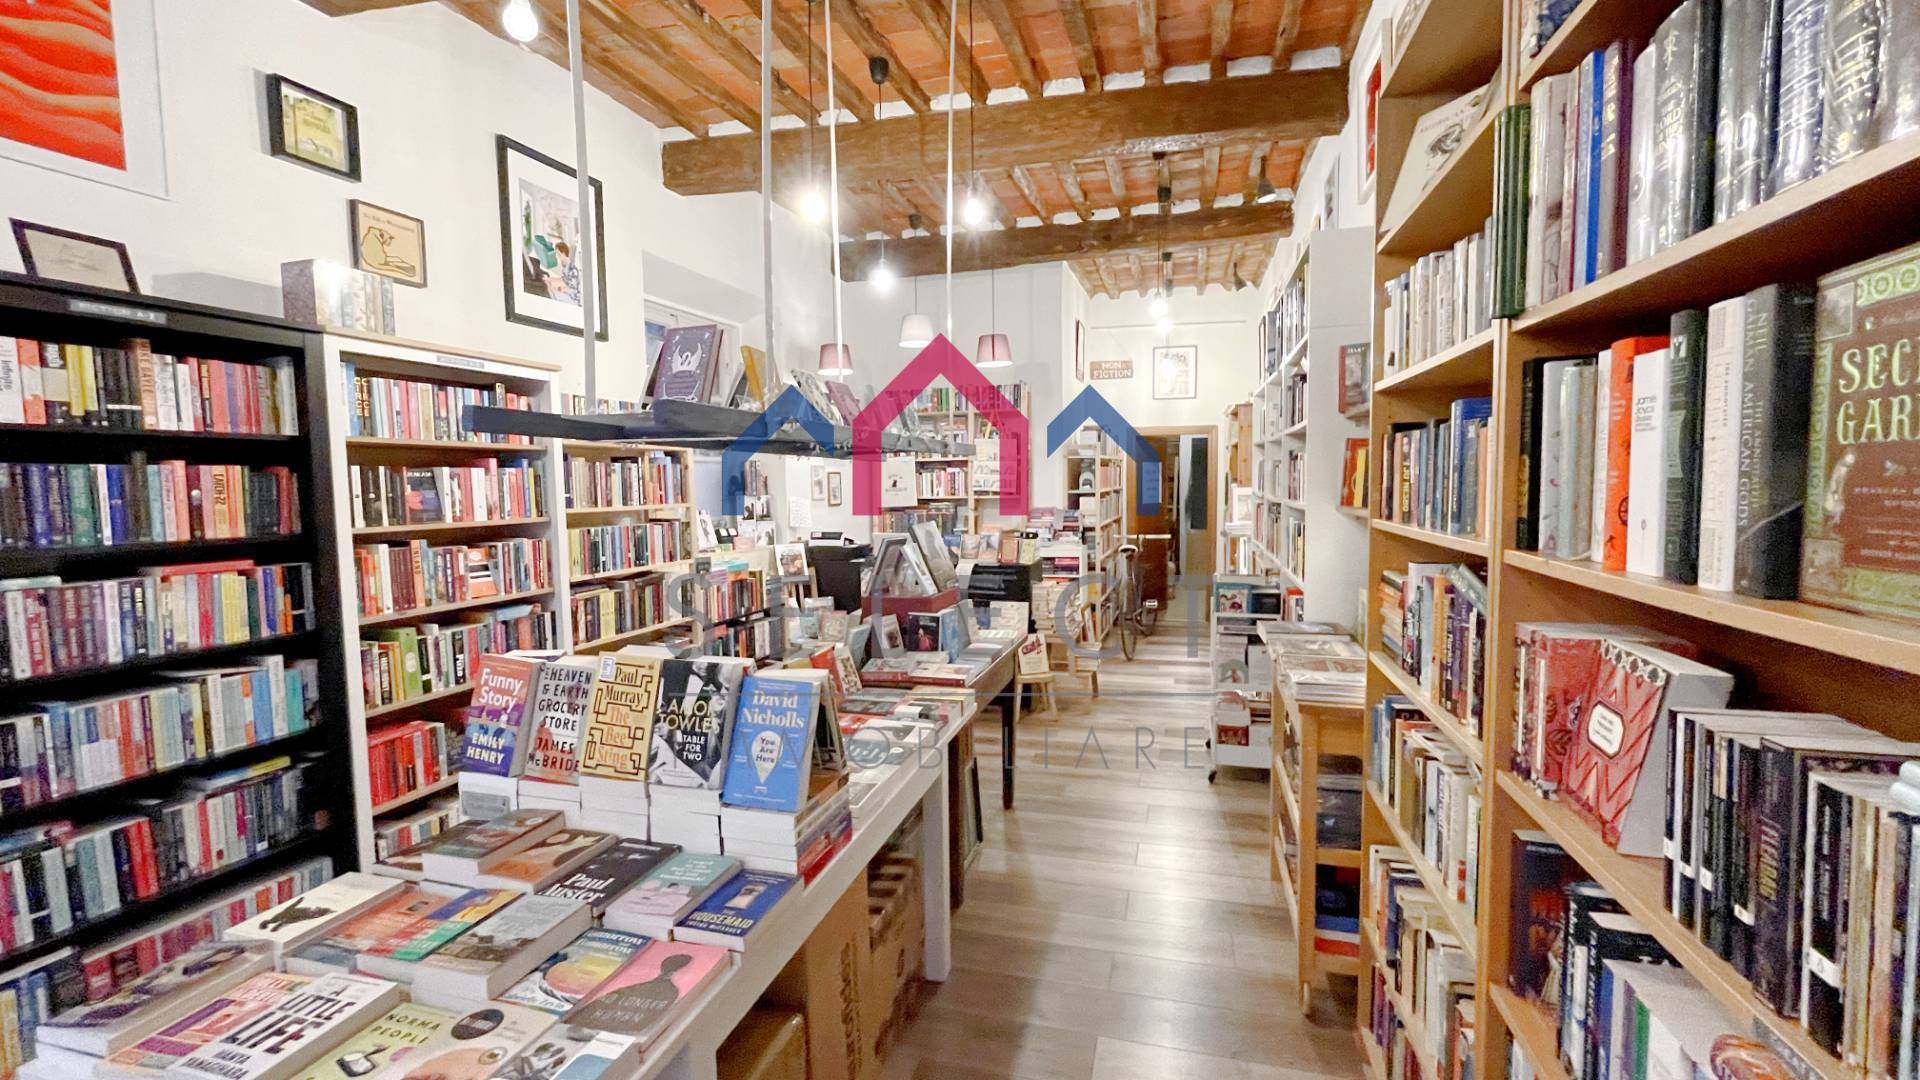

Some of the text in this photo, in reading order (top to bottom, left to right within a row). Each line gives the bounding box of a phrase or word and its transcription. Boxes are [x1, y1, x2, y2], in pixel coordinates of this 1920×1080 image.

[1755, 312, 1768, 350] NEIL
[1101, 361, 1122, 370] NON
[1838, 336, 1920, 393] SEC
[1093, 369, 1132, 379] FICTION
[1741, 382, 1754, 471] AMERICAN
[1836, 394, 1920, 445] GAR
[1737, 478, 1749, 526] GODS
[480, 668, 523, 695] Funny
[550, 667, 592, 684] HEAVEN
[615, 666, 638, 684] Paul
[479, 686, 518, 713] Story
[554, 684, 588, 699] EARTH
[604, 685, 643, 708] Murray
[752, 689, 798, 709] David
[538, 699, 588, 717] GROCERY
[610, 706, 630, 724] The
[542, 715, 577, 732] STORE
[742, 707, 804, 729] Nicholls
[471, 732, 506, 750] EMILY
[606, 726, 627, 745] Bee
[683, 734, 706, 744] TABLE
[760, 737, 776, 746] You
[536, 737, 575, 754] JAMES
[685, 743, 701, 752] FOR
[759, 745, 774, 754] Are
[466, 746, 504, 764] HENRY
[597, 747, 628, 768] Sting
[683, 752, 702, 761] TWO
[756, 754, 775, 763] Here
[563, 873, 616, 890] Paul
[688, 911, 755, 929] HOUSEMAID
[277, 992, 356, 1021] LITTLE
[383, 1013, 442, 1032] NORMA
[219, 1011, 326, 1055] LIFE
